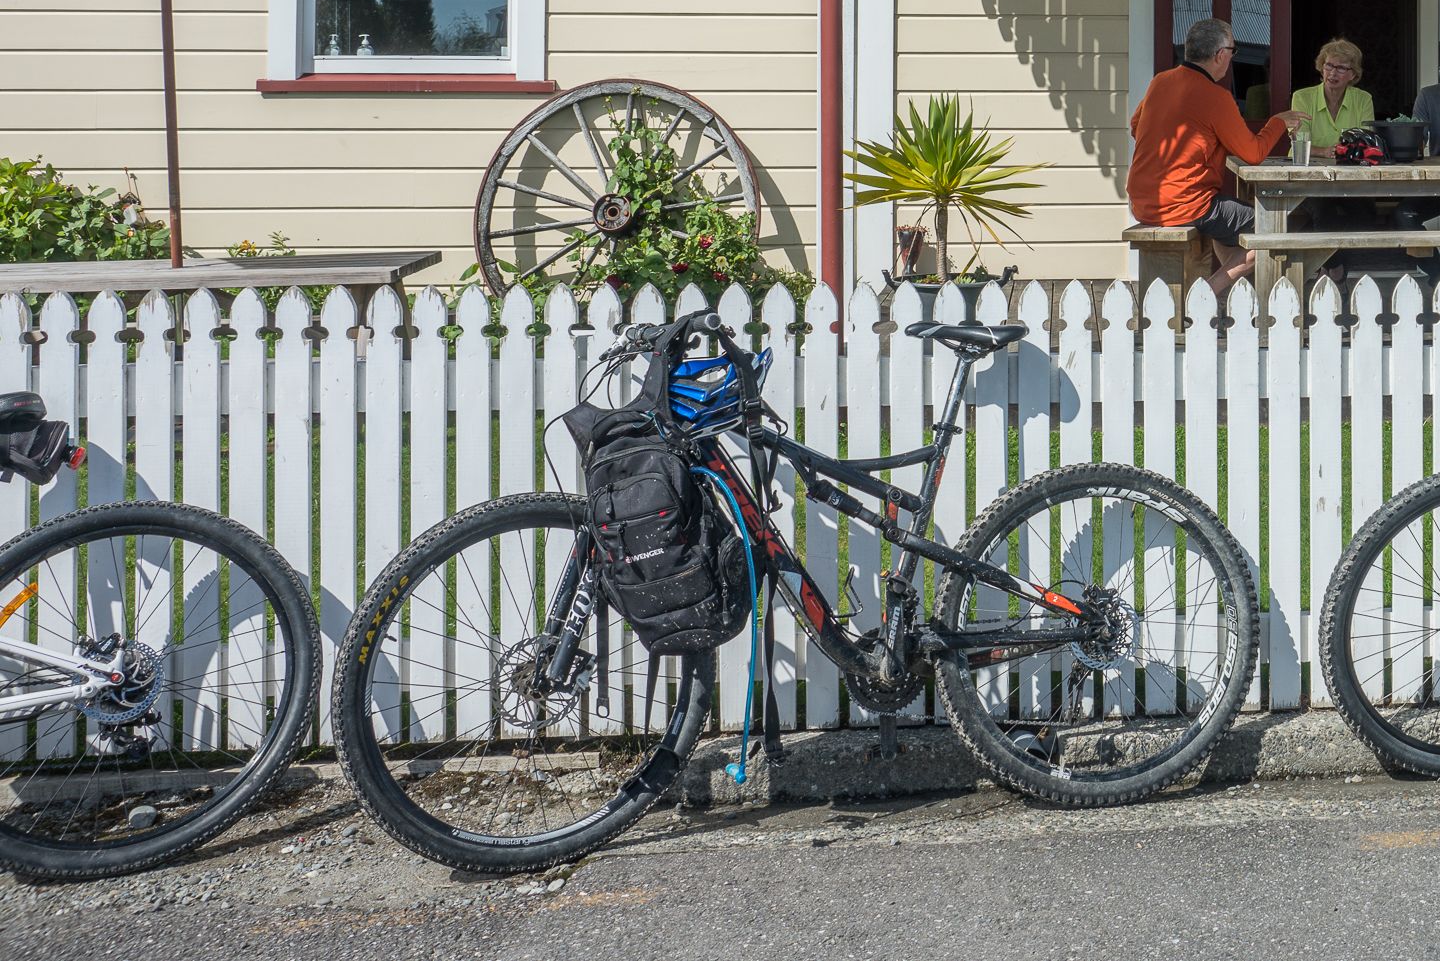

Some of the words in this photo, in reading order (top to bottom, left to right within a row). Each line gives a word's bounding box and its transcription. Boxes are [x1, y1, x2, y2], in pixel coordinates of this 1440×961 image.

[630, 547, 665, 561] WENGER
[358, 575, 409, 665] MAXXIS
[563, 568, 596, 637] FOX
[887, 606, 901, 651] SRAM
